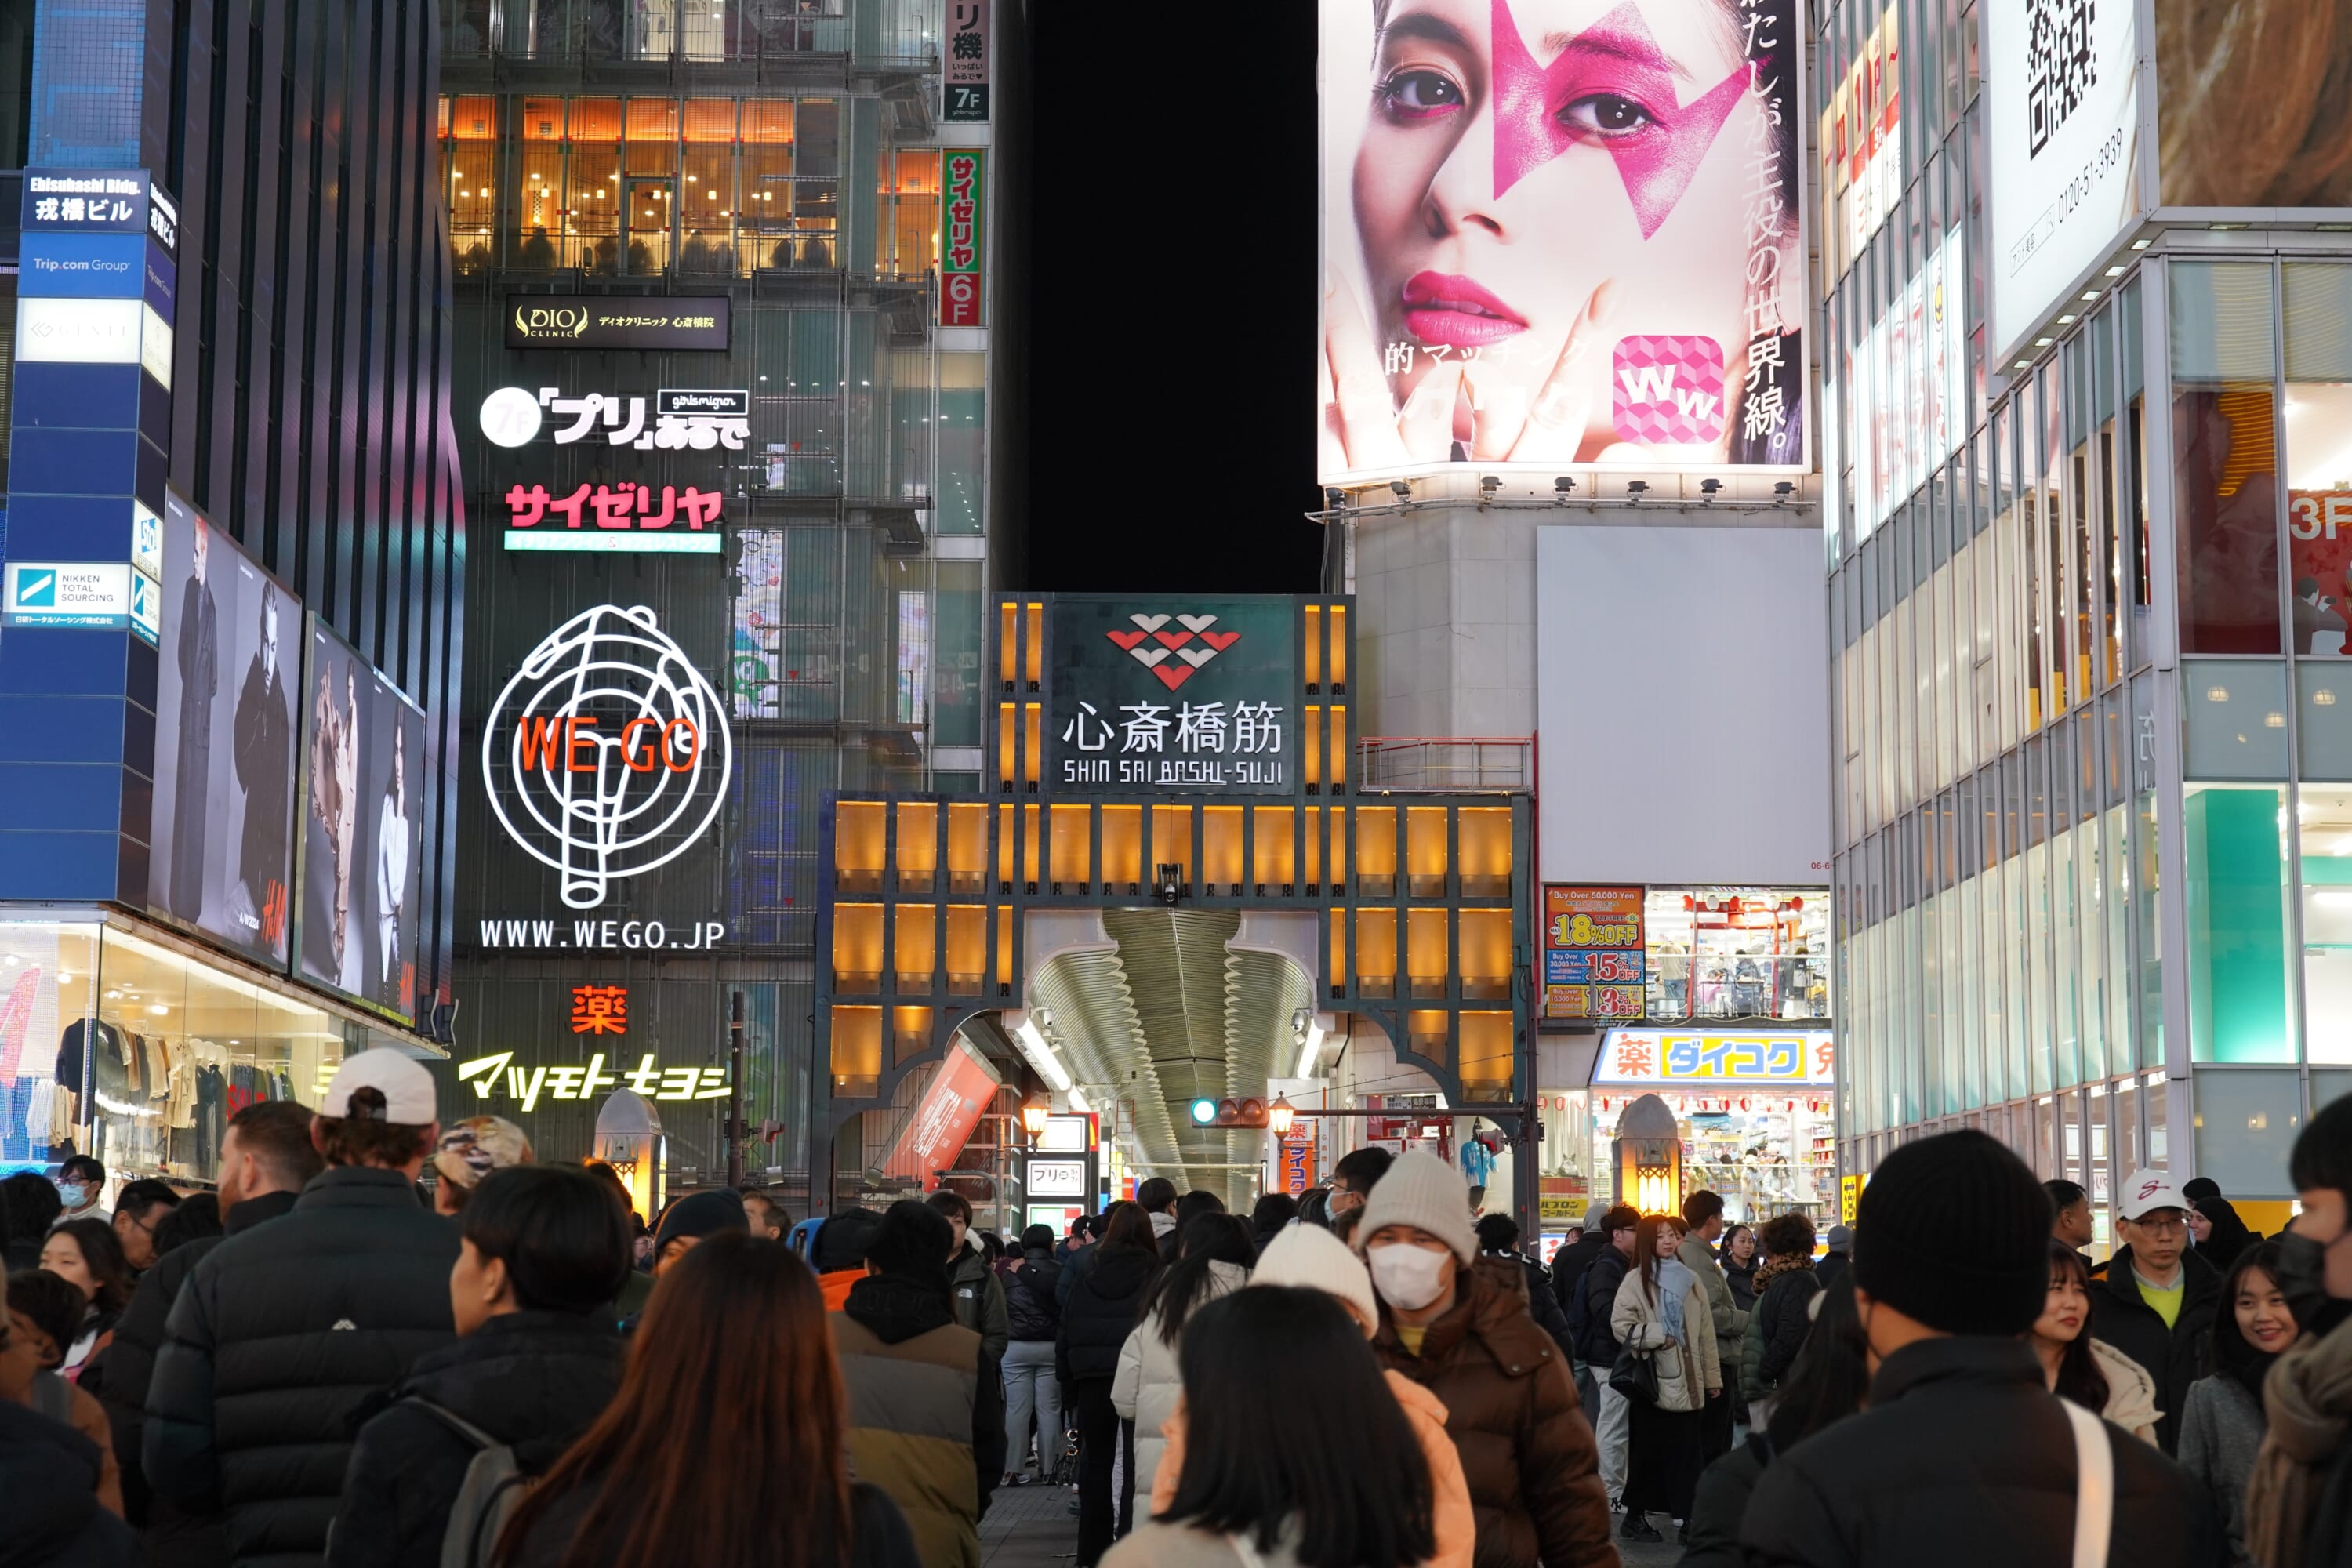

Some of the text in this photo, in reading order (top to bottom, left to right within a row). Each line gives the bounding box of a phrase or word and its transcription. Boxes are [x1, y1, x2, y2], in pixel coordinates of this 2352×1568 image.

[953, 0, 982, 60] リ機
[955, 88, 980, 108] 7F
[30, 177, 141, 195] Ebisubashi Bldg.
[2058, 127, 2122, 223] 0120-51-3939
[35, 197, 133, 222] 戎橋ビル
[950, 157, 974, 269] サイゼリヤ
[1740, 0, 1788, 449] たしが主役の世界線。
[34, 258, 128, 273] Trip.com Group
[950, 275, 972, 324] 6F
[530, 309, 575, 328] DIO
[598, 316, 715, 328] ディオクリニック 心斎橋院
[505, 482, 722, 530] サイゼリヤ
[2290, 497, 2352, 540] 3F
[62, 575, 100, 583] NIKKEN
[62, 584, 93, 593] TOTAL
[61, 593, 114, 603] SOURCING
[15, 615, 114, 626] 日研トータルソーシング株式会社
[1062, 700, 1283, 755] 心斎橋筋
[1064, 760, 1110, 782] SHIN
[1554, 891, 1635, 901] Buy Over 50,000 Yen
[480, 920, 725, 949] WWW.WEGO.JP
[1617, 970, 1641, 981] OFF
[571, 985, 627, 1035] 薬
[1617, 1004, 1642, 1015] OFF
[1617, 1033, 1653, 1077] 薬
[1668, 1039, 1798, 1075] ダイコク
[458, 1051, 733, 1112] マツモトキヨシ
[1288, 1121, 1307, 1139] 薬
[1288, 1142, 1307, 1193] ダイコク
